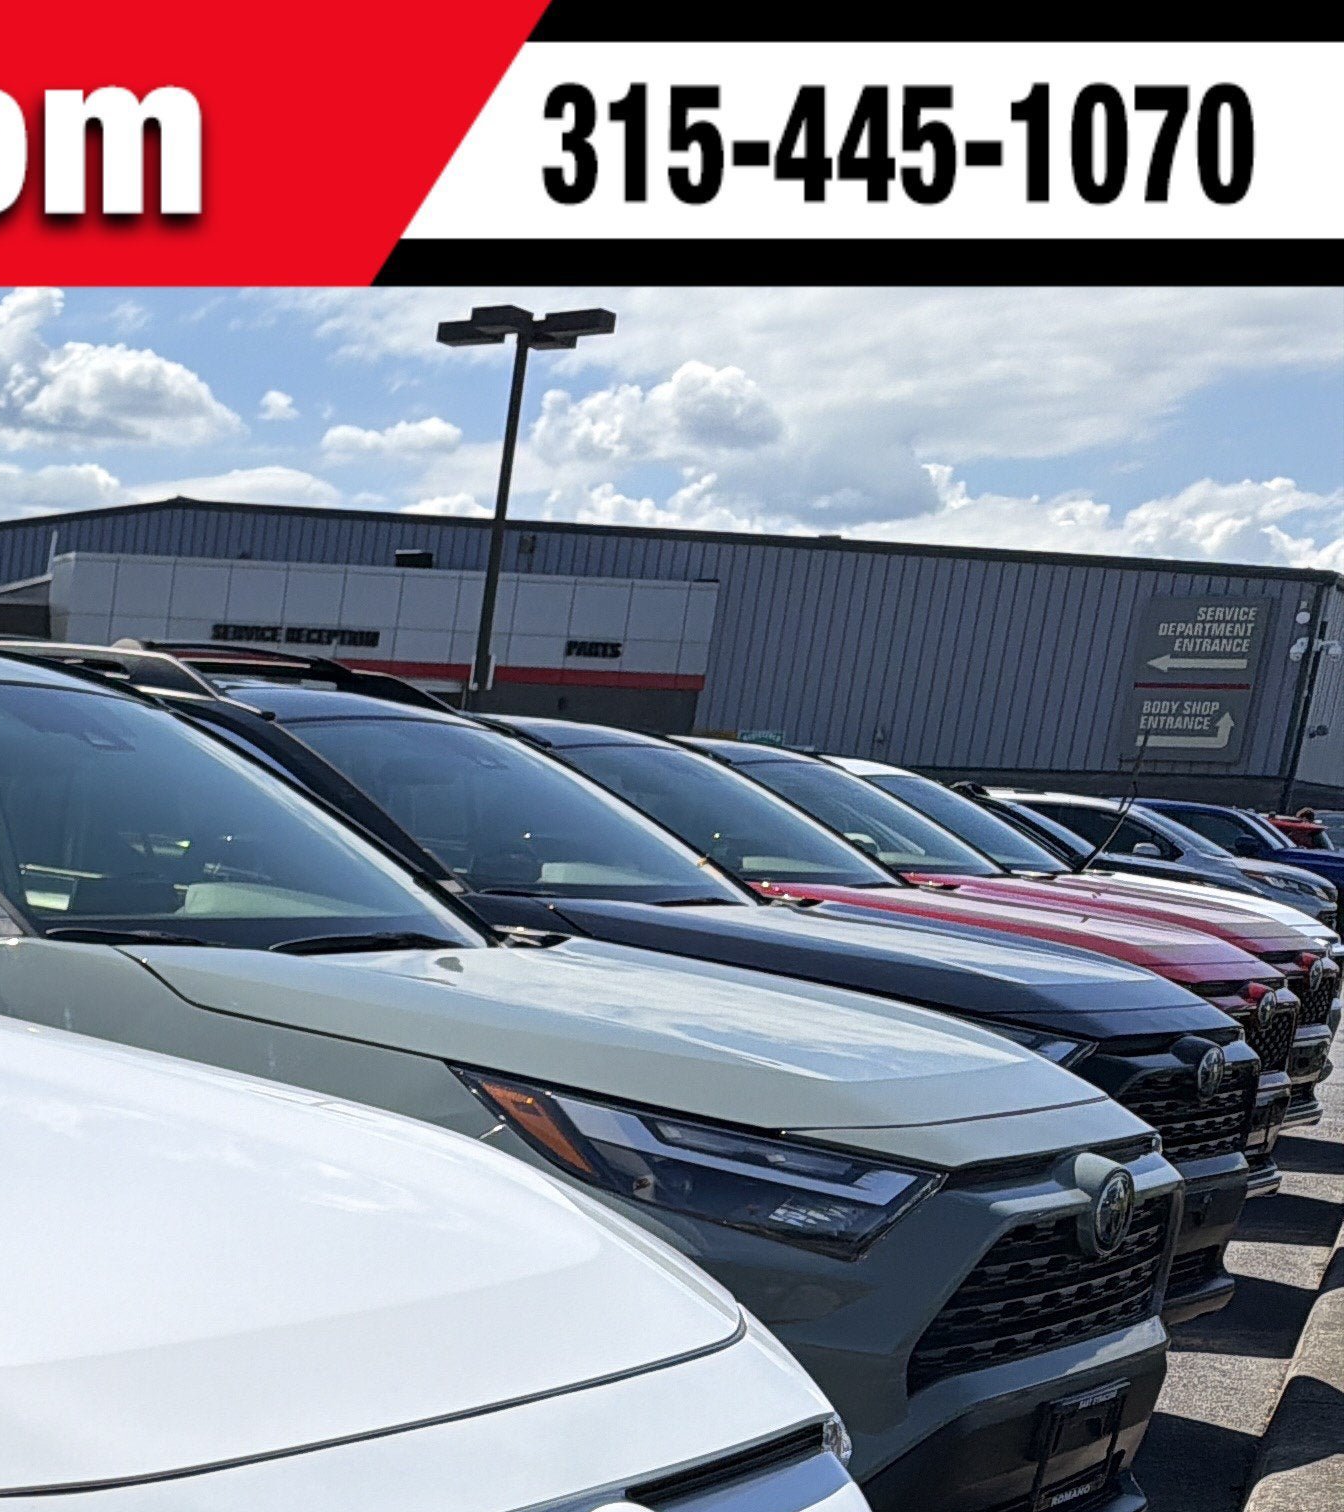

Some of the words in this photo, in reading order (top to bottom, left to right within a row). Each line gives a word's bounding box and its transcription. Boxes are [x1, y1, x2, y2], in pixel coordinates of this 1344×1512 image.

[1197, 607, 1257, 621] SERVICE
[212, 624, 283, 642] SERVICE
[286, 627, 380, 647] RECEPTION
[1158, 623, 1255, 637] DEPARTMENT
[566, 640, 622, 658] PARTS
[1174, 638, 1251, 652] ENTRANCE
[1142, 701, 1179, 714] BODY
[1182, 702, 1220, 715] SHOP
[1140, 716, 1211, 730] ENTRANCE
